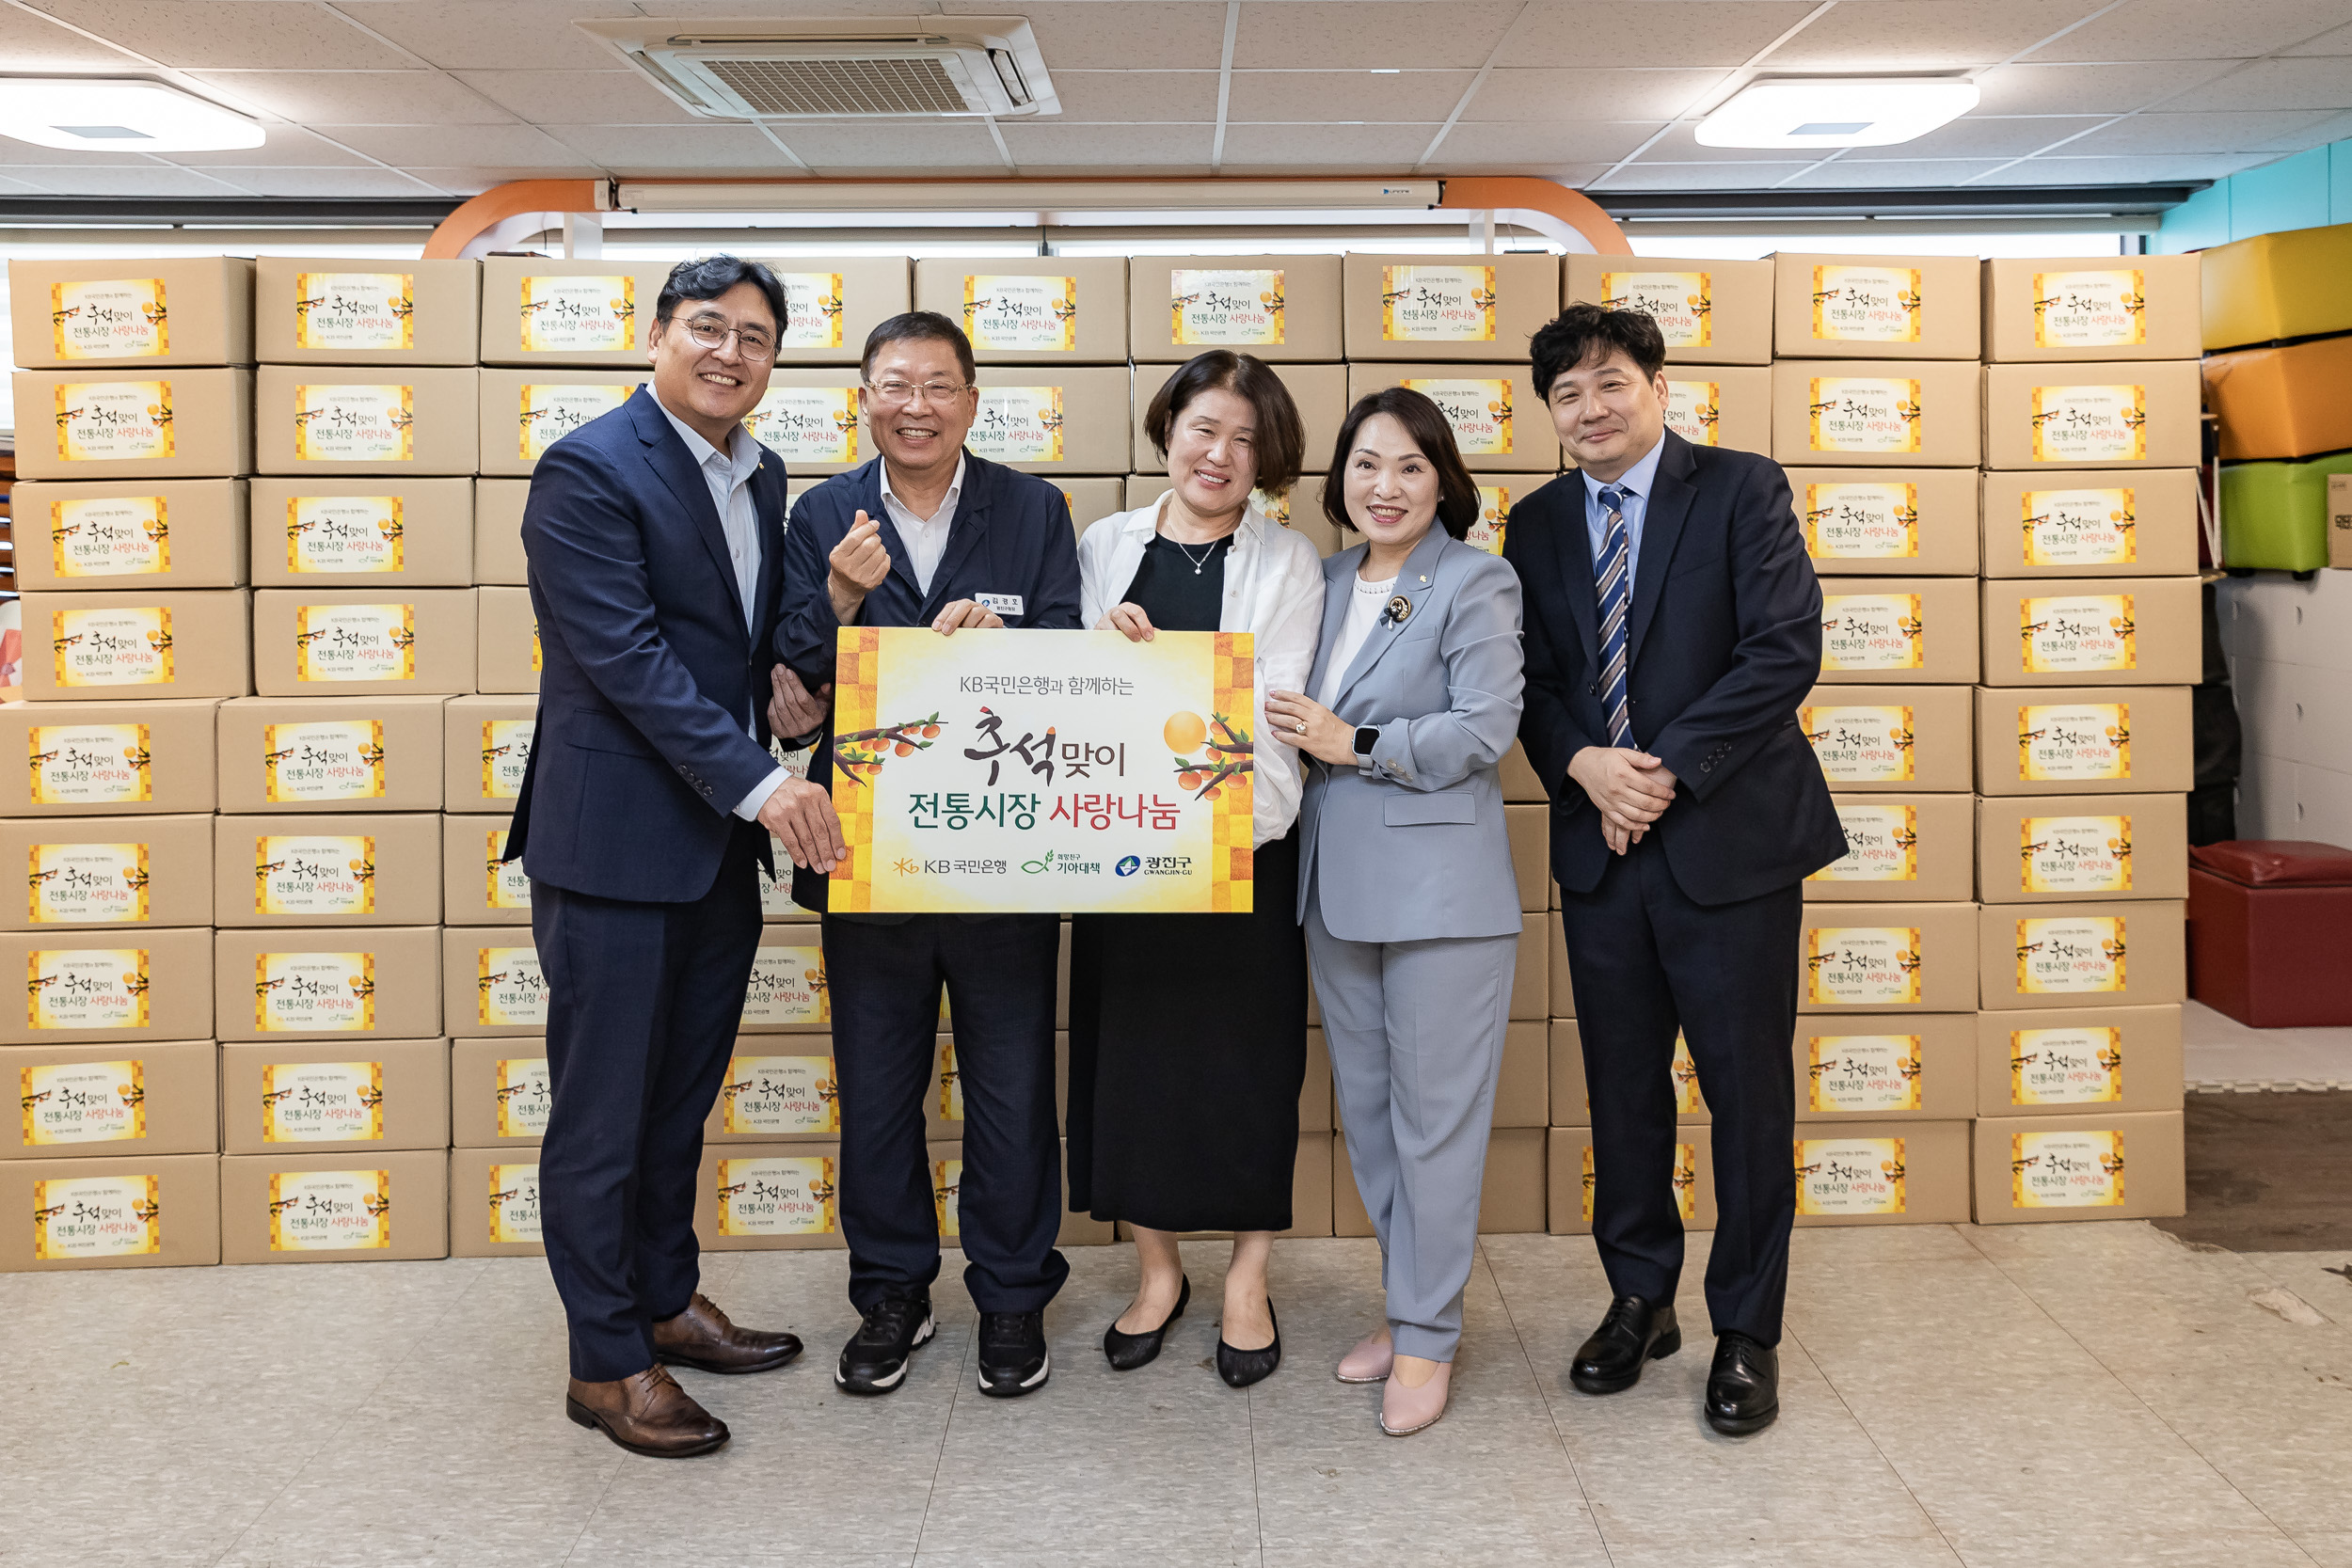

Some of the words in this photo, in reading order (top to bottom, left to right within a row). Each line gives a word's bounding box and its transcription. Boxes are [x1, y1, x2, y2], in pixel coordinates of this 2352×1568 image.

[1192, 314, 1227, 325] 전통시장
[1231, 314, 1264, 324] 사랑나눔
[1403, 310, 1438, 320] 전통시장
[1441, 310, 1475, 320] 사랑나눔
[1832, 309, 1866, 321] 전통시장
[1868, 311, 1901, 321] 사랑나눔
[2054, 316, 2089, 326] 전통시장
[2091, 315, 2125, 325] 사랑나눔
[317, 318, 354, 328] 전통시장
[357, 319, 392, 328] 사랑나눔
[541, 321, 576, 331] 전통시장
[580, 321, 614, 330] 사랑나눔
[983, 320, 1018, 330] 전통시장
[1022, 320, 1056, 330] 사랑나눔
[1659, 316, 1692, 326] 사랑나눔
[74, 326, 109, 338] 전통시장
[113, 325, 148, 336] 사랑나눔
[1458, 423, 1492, 433] 사랑나눔
[1830, 421, 1864, 432] 전통시장
[1867, 421, 1900, 432] 사랑나눔
[78, 428, 114, 439] 전통시장
[118, 427, 153, 438] 사랑나눔
[316, 429, 353, 439] 전통시장
[357, 430, 392, 439] 사랑나눔
[765, 432, 800, 442] 전통시장
[803, 432, 837, 442] 사랑나눔
[970, 431, 1005, 441] 전통시장
[1009, 431, 1043, 440] 사랑나눔
[2052, 430, 2088, 440] 전통시장
[2090, 430, 2125, 439] 사랑나눔
[1827, 528, 1861, 538] 전통시장
[1865, 528, 1899, 537] 사랑나눔
[2042, 533, 2077, 545] 전통시장
[2081, 533, 2115, 544] 사랑나눔
[74, 544, 110, 556] 전통시장
[114, 543, 149, 553] 사랑나눔
[308, 542, 343, 552] 전통시장
[347, 542, 383, 551] 사랑나눔
[1831, 639, 1866, 650] 전통시장
[1868, 639, 1903, 649] 사랑나눔
[2042, 641, 2076, 652] 전통시장
[2080, 640, 2115, 650] 사랑나눔
[76, 654, 112, 665] 전통시장
[117, 653, 152, 664] 사랑나눔
[318, 650, 354, 660] 전통시장
[358, 649, 393, 659] 사랑나눔
[960, 675, 1063, 695] KB국민은행과
[1068, 675, 1134, 696] 함께하는
[964, 706, 1124, 786] 추석맞이
[1822, 751, 1857, 761] 전통시장
[1861, 751, 1894, 760] 사랑나눔
[2039, 749, 2073, 759] 전통시장
[2076, 748, 2110, 758] 사랑나눔
[52, 771, 88, 783] 전통시장
[92, 770, 129, 781] 사랑나눔
[287, 768, 324, 780] 전통시장
[327, 767, 363, 778] 사랑나눔
[909, 792, 1041, 830] 전통시장
[1049, 793, 1181, 831] 사랑나눔
[1863, 849, 1897, 860] 사랑나눔
[1145, 856, 1192, 869] 광진구
[2041, 861, 2074, 872] 전통시장
[2078, 861, 2112, 870] 사랑나눔
[1057, 862, 1101, 875] 기아대책
[277, 882, 313, 893] 전통시장
[317, 882, 353, 893] 사랑나눔
[50, 891, 87, 901] 전통시장
[91, 890, 127, 900] 사랑나눔
[2036, 962, 2070, 973] 전통시장
[2073, 961, 2106, 972] 사랑나눔
[1828, 973, 1863, 983] 전통시장
[1867, 973, 1900, 983] 사랑나눔
[50, 996, 87, 1007] 전통시장
[90, 996, 127, 1006] 사랑나눔
[500, 993, 535, 1004] 전통시장
[774, 992, 808, 1003] 사랑나눔
[277, 999, 313, 1010] 전통시장
[317, 999, 353, 1009] 사랑나눔
[2031, 1072, 2064, 1084] 전통시장
[2068, 1071, 2102, 1082] 사랑나눔
[1830, 1080, 1864, 1091] 전통시장
[1867, 1080, 1901, 1090] 사랑나눔
[744, 1101, 780, 1113] 전통시장
[784, 1101, 818, 1112] 사랑나눔
[44, 1110, 82, 1122] 전통시장
[86, 1108, 123, 1119] 사랑나눔
[284, 1109, 322, 1120] 전통시장
[326, 1109, 361, 1119] 사랑나눔
[2032, 1176, 2066, 1187] 전통시장
[2070, 1175, 2104, 1185] 사랑나눔
[1814, 1183, 1849, 1194] 전통시장
[1851, 1183, 1885, 1193] 사랑나눔
[739, 1203, 774, 1214] 전통시장
[778, 1203, 814, 1213] 사랑나눔
[291, 1218, 328, 1229] 전통시장
[332, 1217, 368, 1227] 사랑나눔
[57, 1225, 96, 1236] 전통시장
[100, 1223, 137, 1234] 사랑나눔
